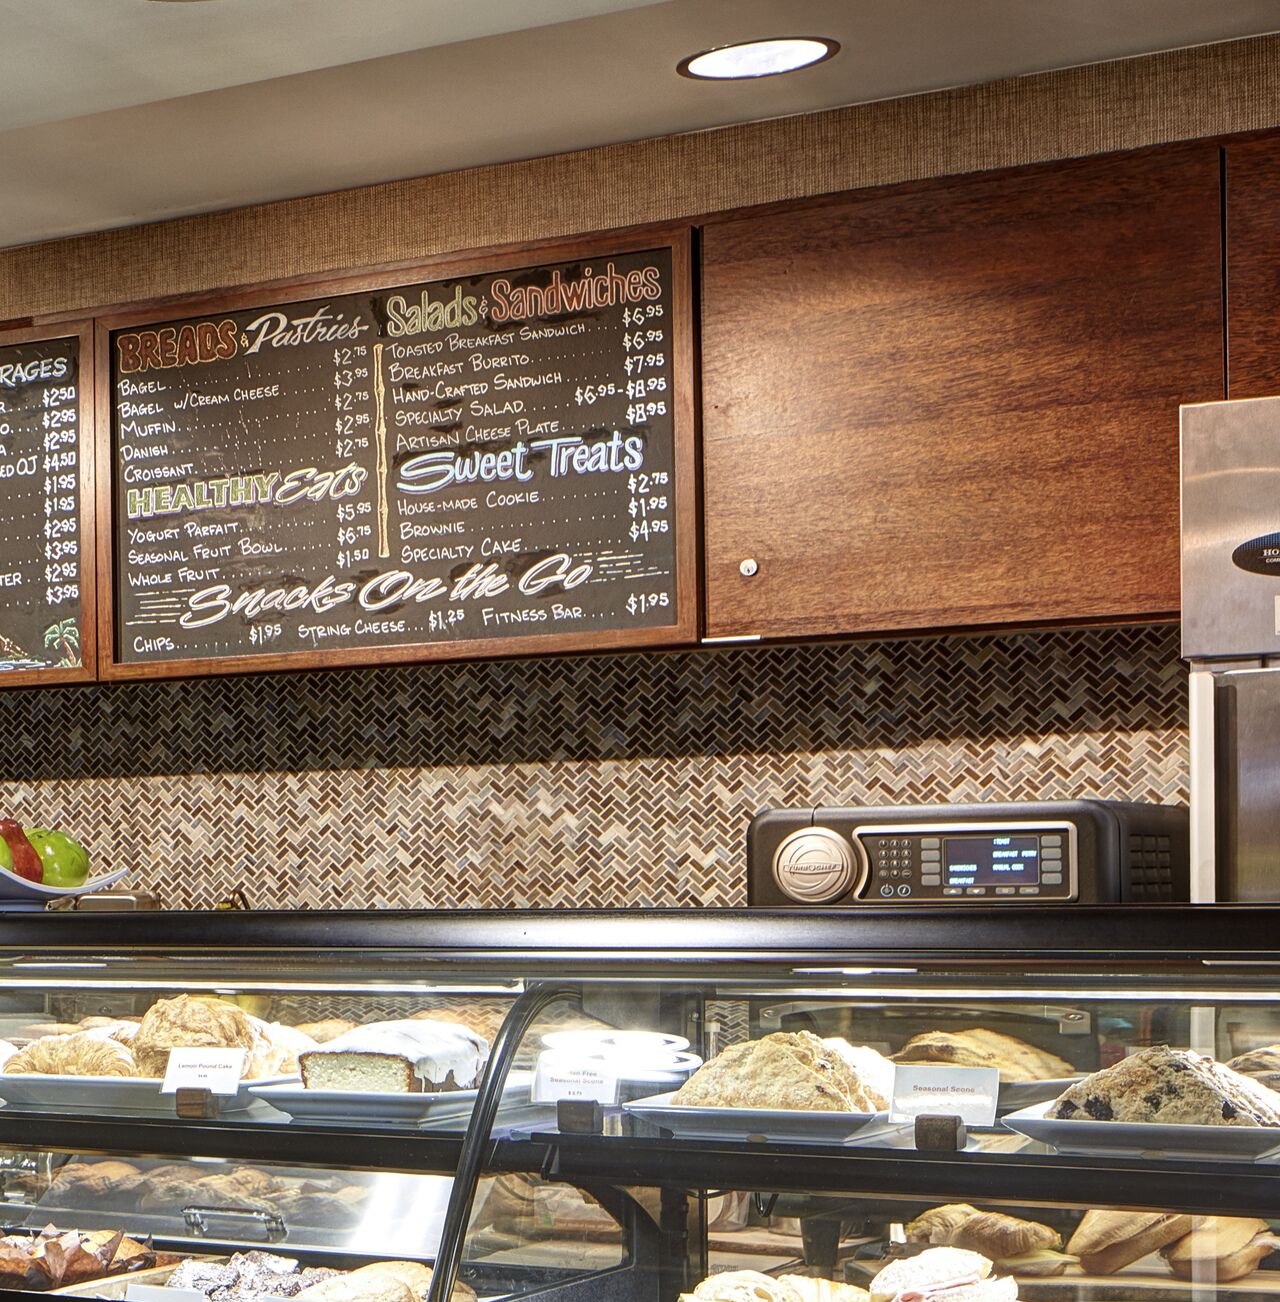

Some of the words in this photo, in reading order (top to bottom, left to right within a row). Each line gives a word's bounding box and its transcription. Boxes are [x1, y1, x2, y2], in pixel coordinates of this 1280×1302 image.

[386, 287, 478, 338] Salads
[491, 263, 662, 323] Sandwiches
[117, 319, 238, 373] BREADS
[244, 306, 367, 354] Pastries
[385, 341, 443, 360] TOASTED
[445, 332, 513, 350] BREAKFAST
[390, 362, 464, 382] BREAKFAST
[469, 352, 529, 370] BURRITO
[118, 381, 166, 397] BAGEL
[117, 401, 164, 417] BAGEL
[470, 400, 523, 417] SALAD
[120, 423, 176, 438] MUFFIN
[396, 433, 459, 451] ARTISAN
[465, 426, 511, 444] CHEESE
[515, 419, 559, 438] PLATE
[121, 445, 169, 460] DANISH
[396, 441, 533, 494] Sweet
[532, 432, 644, 477] Treats
[124, 464, 194, 483] CROISSANT
[127, 471, 282, 519] HEALTHY
[275, 461, 368, 504] Eats
[485, 491, 539, 508] COOKIE
[128, 527, 180, 544] YOGURT
[185, 522, 238, 538] PARFAIT
[400, 522, 465, 539] BROWNIE
[128, 550, 189, 565] SEASONAL
[238, 538, 282, 555] BOWL
[401, 545, 473, 564] SPECIALTY
[480, 538, 522, 556] CAKE
[180, 575, 357, 629] Snacks
[360, 569, 446, 612] On
[447, 562, 512, 602] the
[518, 553, 594, 596] Go
[482, 606, 550, 625] FITNESS
[553, 603, 581, 620] BAR
[133, 637, 175, 653] CHIPS
